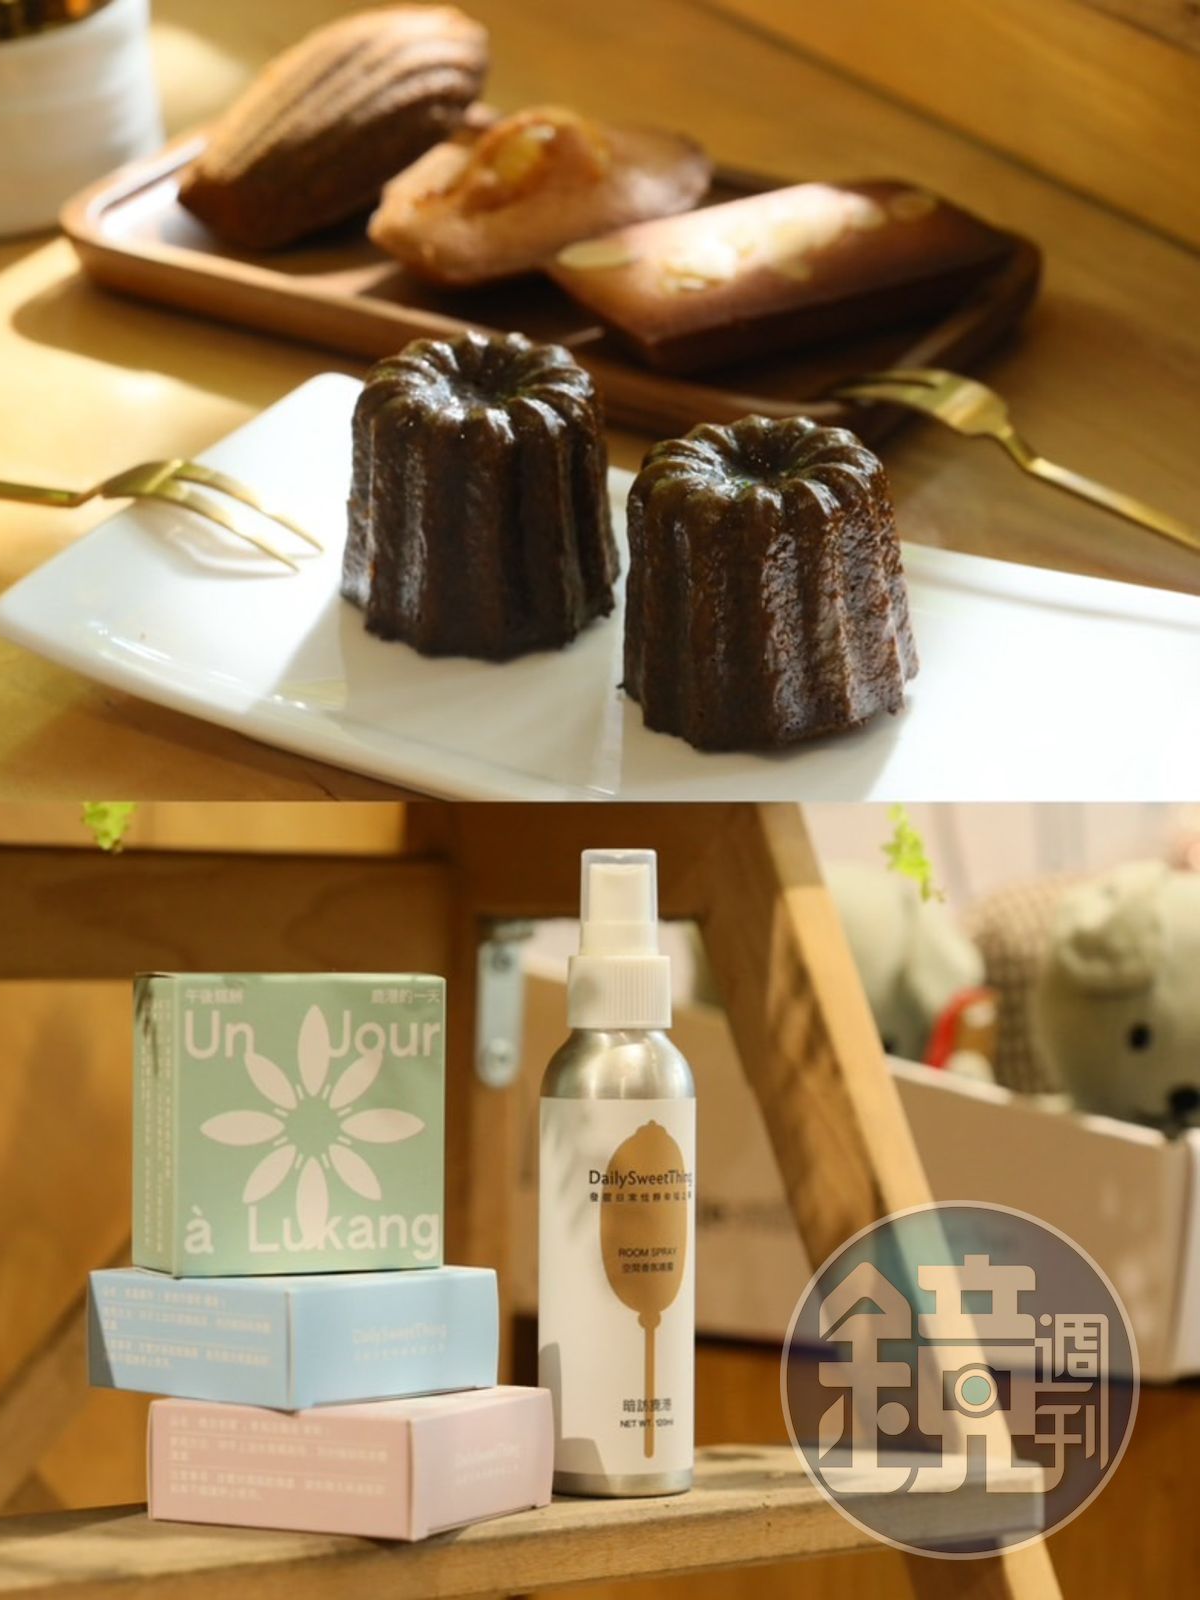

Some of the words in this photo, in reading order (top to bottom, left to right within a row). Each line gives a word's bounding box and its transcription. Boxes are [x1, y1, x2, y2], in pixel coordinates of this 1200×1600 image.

[185, 1009, 255, 1059] Un
[327, 1009, 441, 1059] Jour
[184, 1205, 214, 1254] à
[248, 1204, 441, 1261] Lukang
[618, 1248, 649, 1258] ROOM
